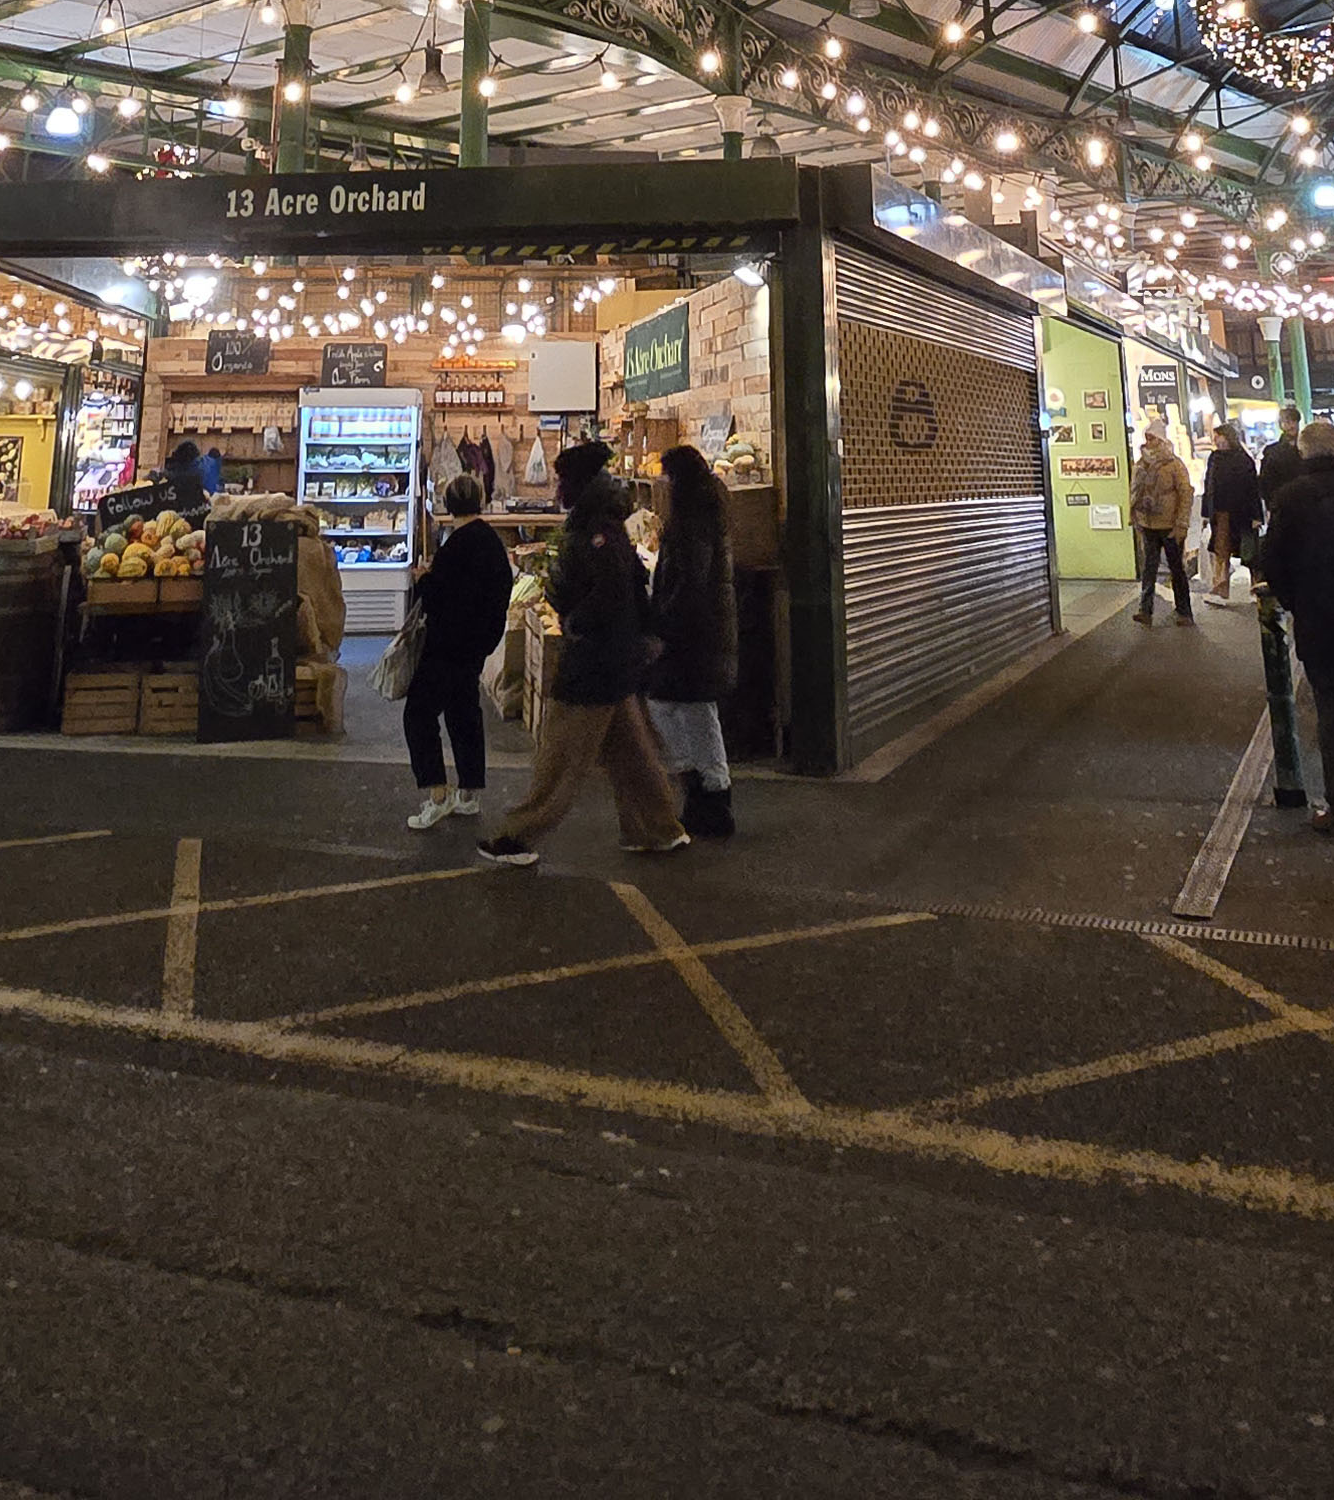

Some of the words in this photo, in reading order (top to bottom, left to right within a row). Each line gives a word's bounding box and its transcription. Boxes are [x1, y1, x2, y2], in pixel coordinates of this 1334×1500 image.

[226, 189, 254, 218] 13
[264, 188, 319, 216] Acre
[330, 182, 426, 214] Orchard
[241, 523, 262, 547] 13
